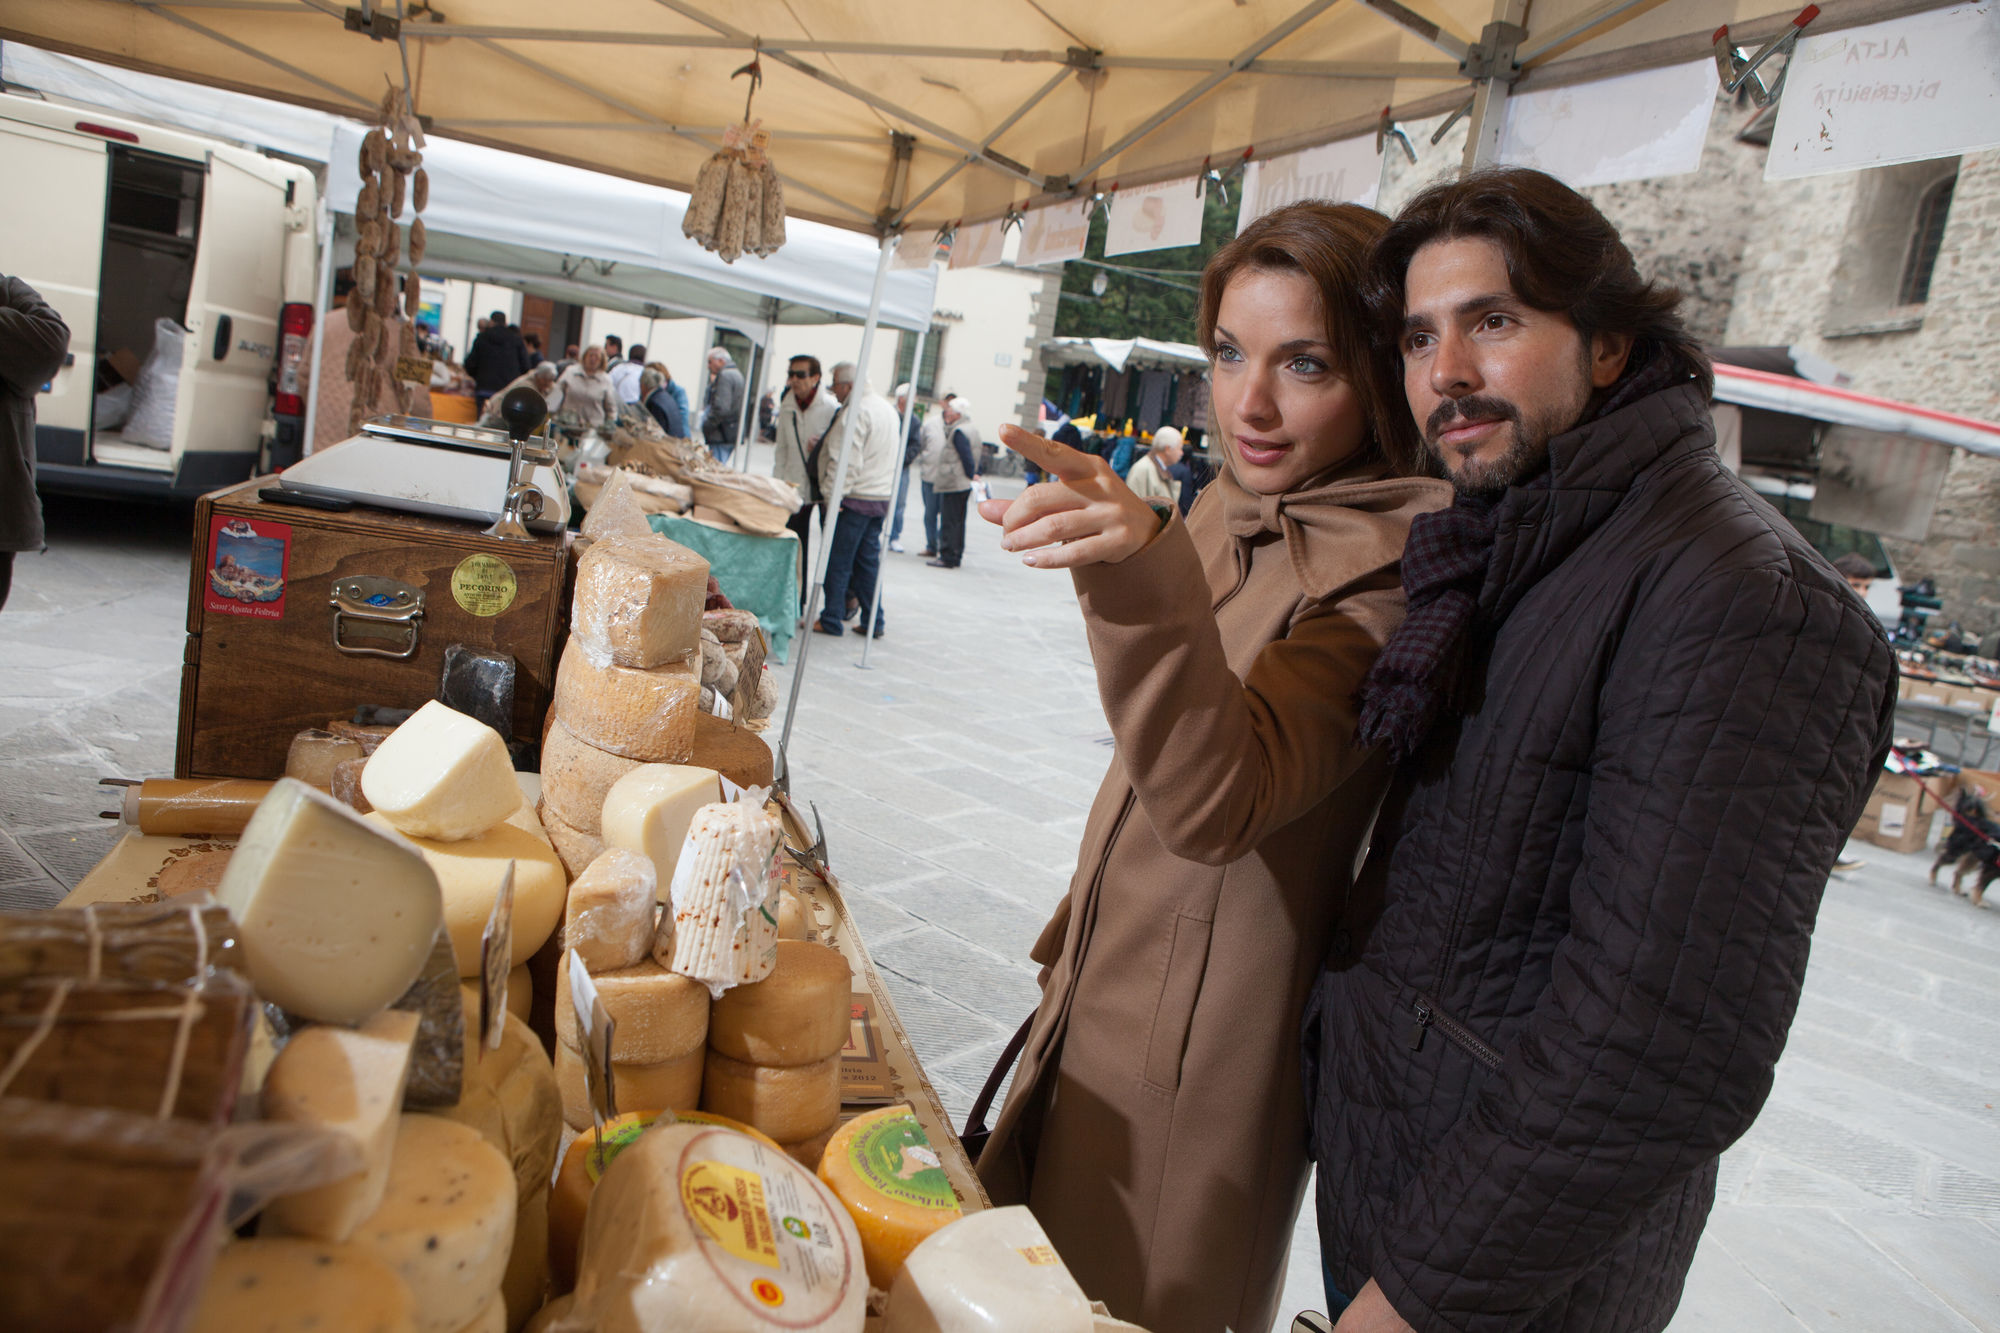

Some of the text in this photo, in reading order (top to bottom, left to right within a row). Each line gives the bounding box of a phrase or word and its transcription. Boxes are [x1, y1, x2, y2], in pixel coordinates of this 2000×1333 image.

[459, 583, 508, 592] PECORINO
[209, 601, 281, 617] Sant'Agata Feltria
